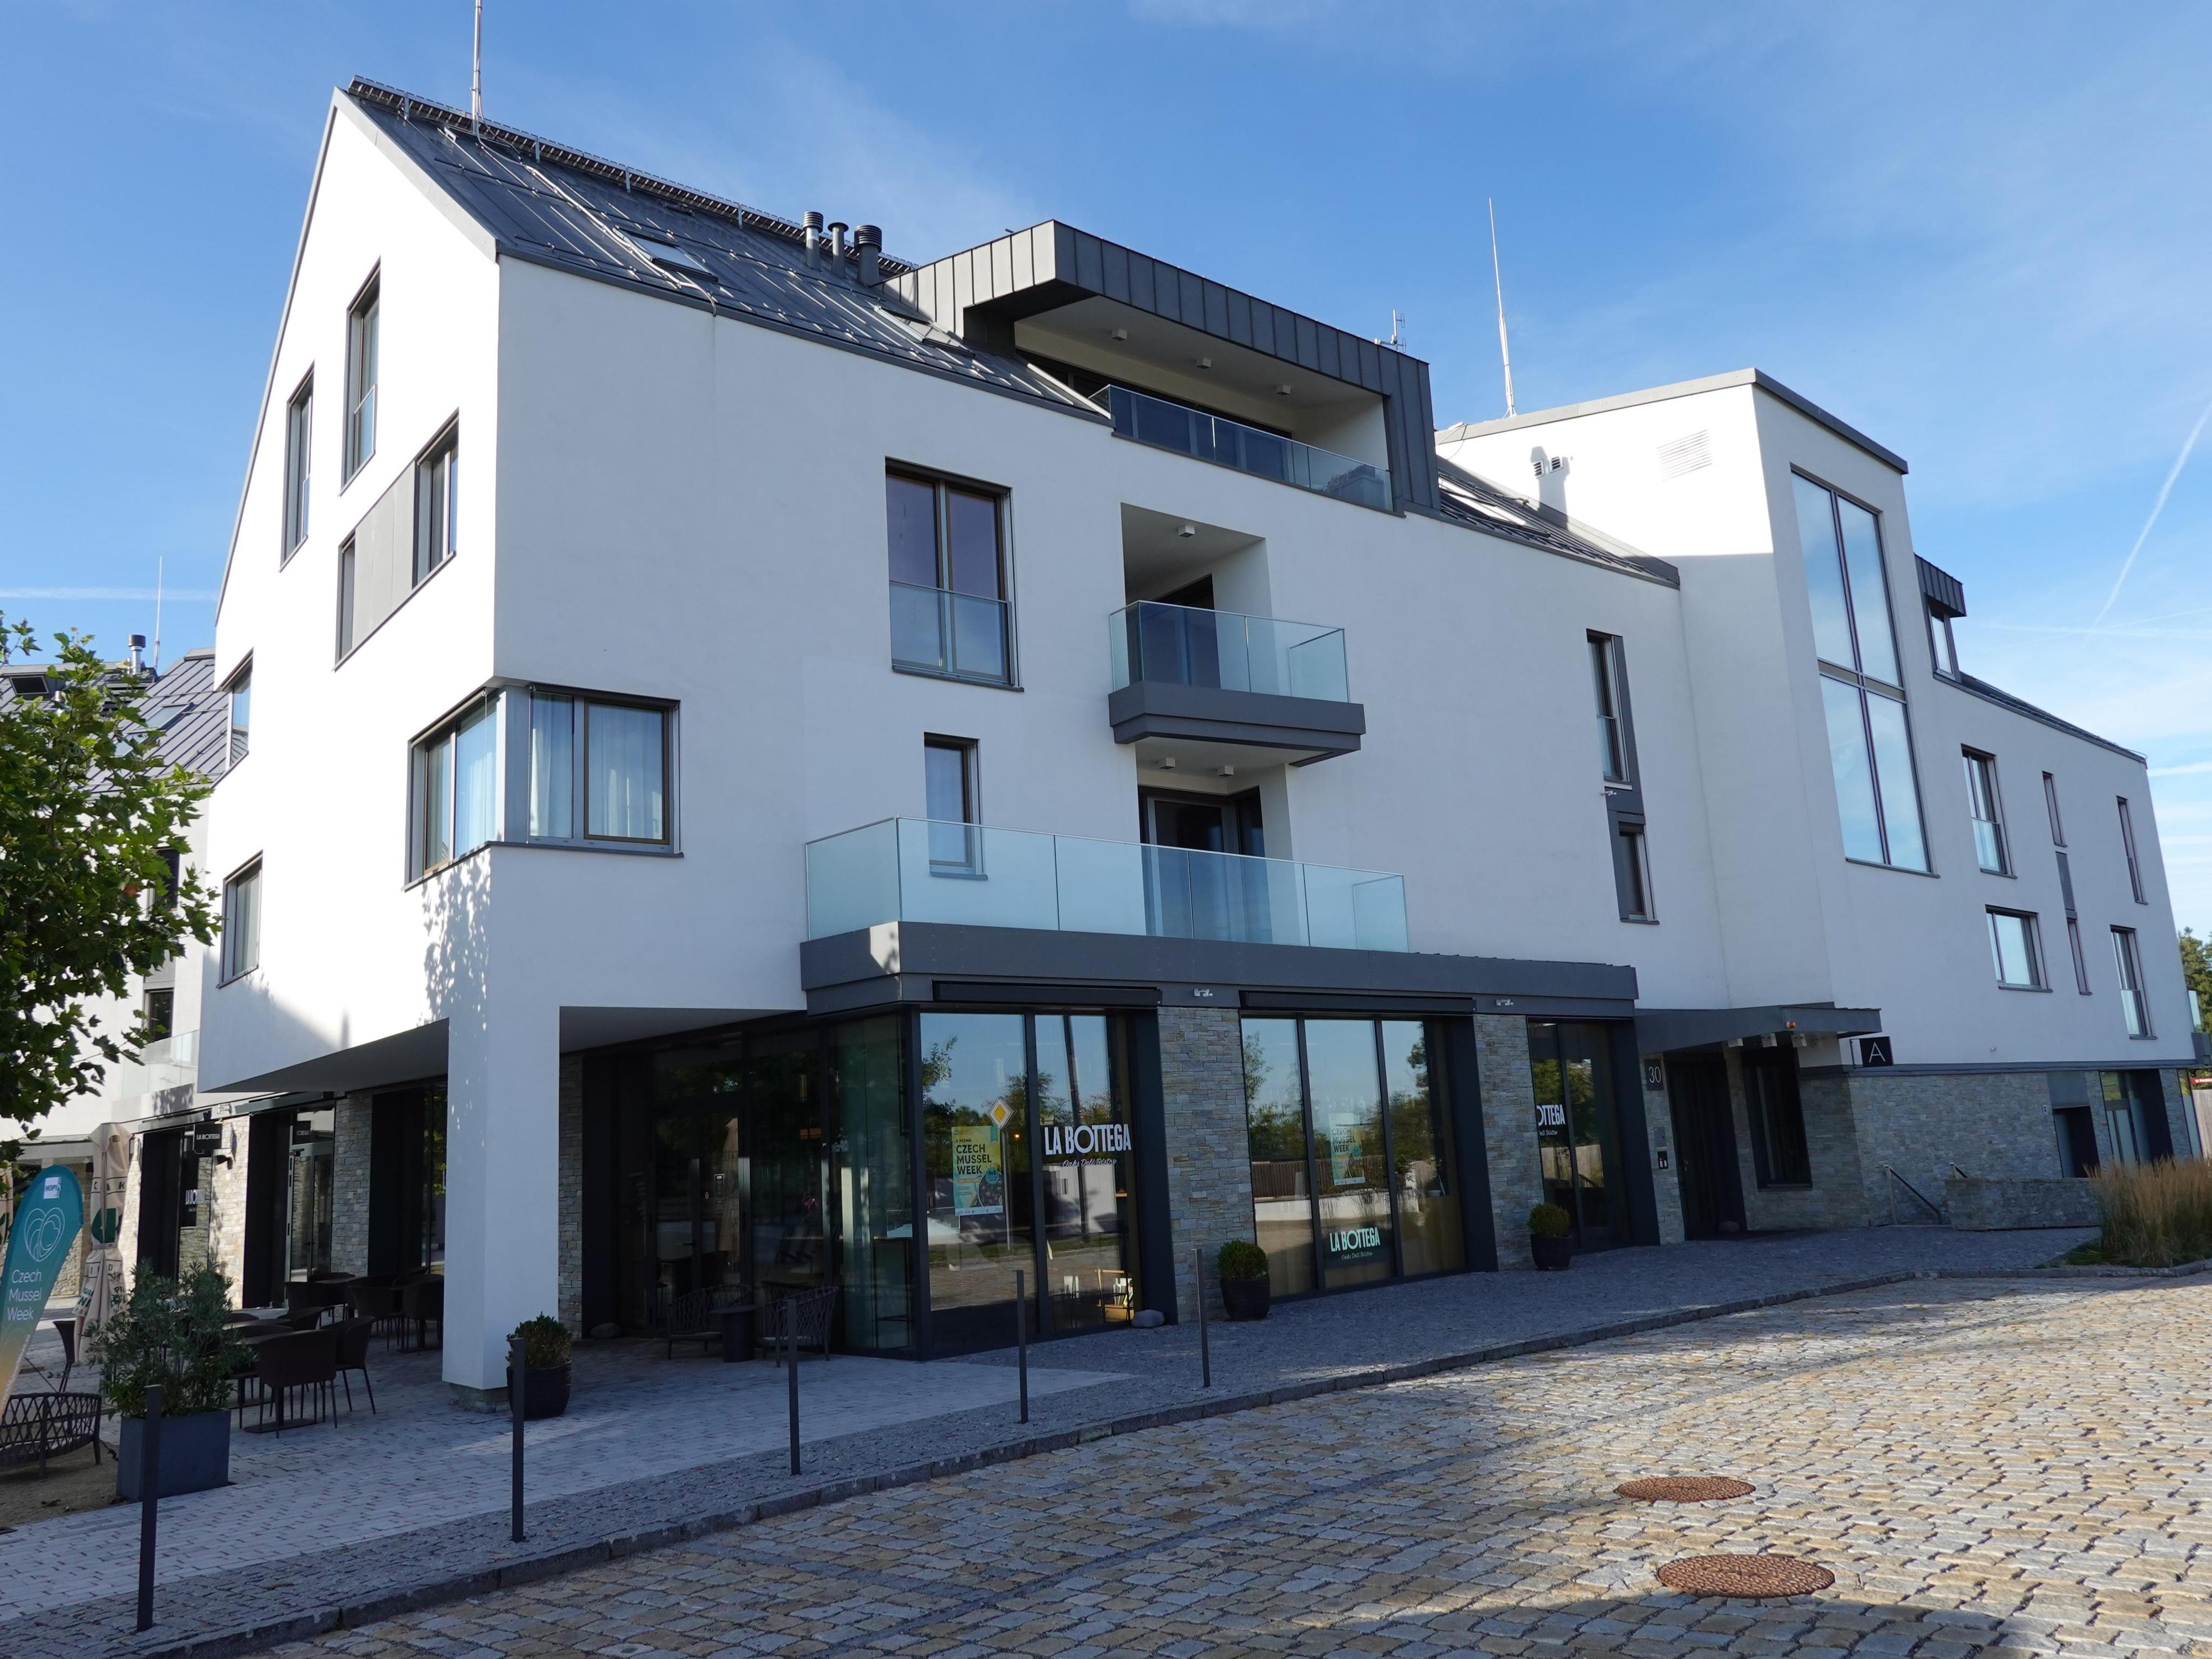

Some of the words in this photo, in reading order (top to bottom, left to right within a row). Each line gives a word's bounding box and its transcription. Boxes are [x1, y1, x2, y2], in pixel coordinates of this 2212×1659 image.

[1869, 1042, 1886, 1063] A
[1648, 1066, 1661, 1083] 30
[1536, 1104, 1566, 1126] OTTEGA
[1332, 1127, 1352, 1135] CZECH
[1045, 1126, 1062, 1155] LA
[1065, 1124, 1132, 1154] BOTTEGA
[1333, 1136, 1356, 1145] MUSSEL
[956, 1144, 985, 1154] CZECH
[1333, 1144, 1349, 1152] WEEK
[957, 1154, 992, 1165] MUSSEL
[1062, 1159, 1079, 1167] Oaks
[1081, 1158, 1095, 1167] Deli
[957, 1165, 982, 1175] WEEK
[1329, 1232, 1340, 1252] LA
[1341, 1227, 1381, 1250] BOTTEGA
[12, 1268, 42, 1283] Czech
[9, 1287, 43, 1302] Mussel
[8, 1306, 34, 1321] Week
